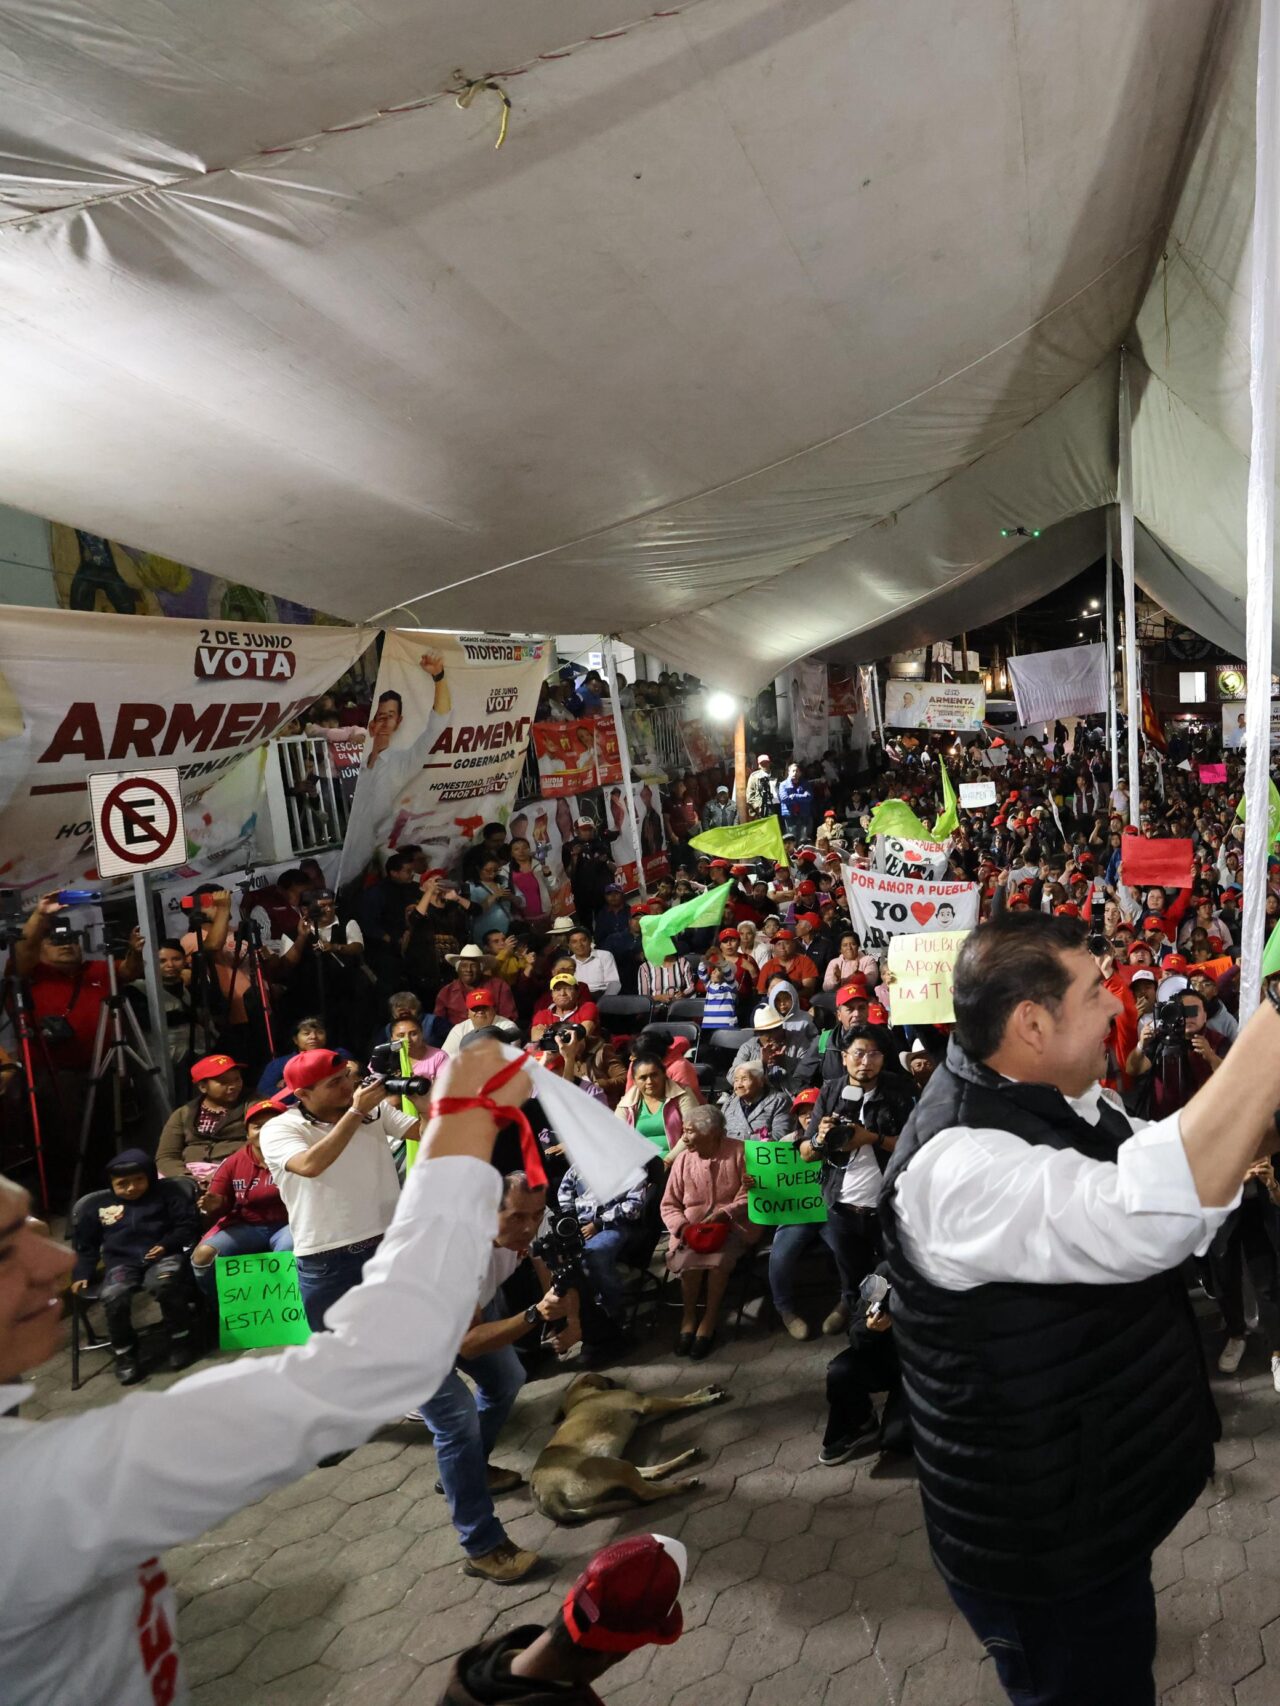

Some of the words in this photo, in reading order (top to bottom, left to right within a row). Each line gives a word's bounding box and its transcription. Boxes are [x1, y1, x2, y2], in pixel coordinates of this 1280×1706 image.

[200, 629, 211, 644] 2
[215, 631, 240, 645] DE
[242, 633, 293, 649] JUNIO
[464, 644, 514, 661] morena
[200, 648, 292, 678] VOTA
[502, 687, 518, 695] JUNIO
[928, 696, 975, 706] ARMENTA
[428, 716, 532, 755] ARMENT
[333, 742, 364, 752] ESCUE
[453, 749, 516, 770] GOBERNADOR
[442, 790, 470, 800] AMOR
[122, 799, 155, 845] E
[851, 872, 875, 890] POR
[878, 880, 914, 895] AMOR
[917, 882, 925, 895] A
[929, 881, 974, 896] PUEBLA
[871, 900, 908, 922] YO
[919, 982, 942, 1000] 4T
[756, 1146, 800, 1166] BET
[225, 1258, 279, 1277] BETO
[223, 1287, 252, 1304] SN
[224, 1309, 275, 1331] ESTA
